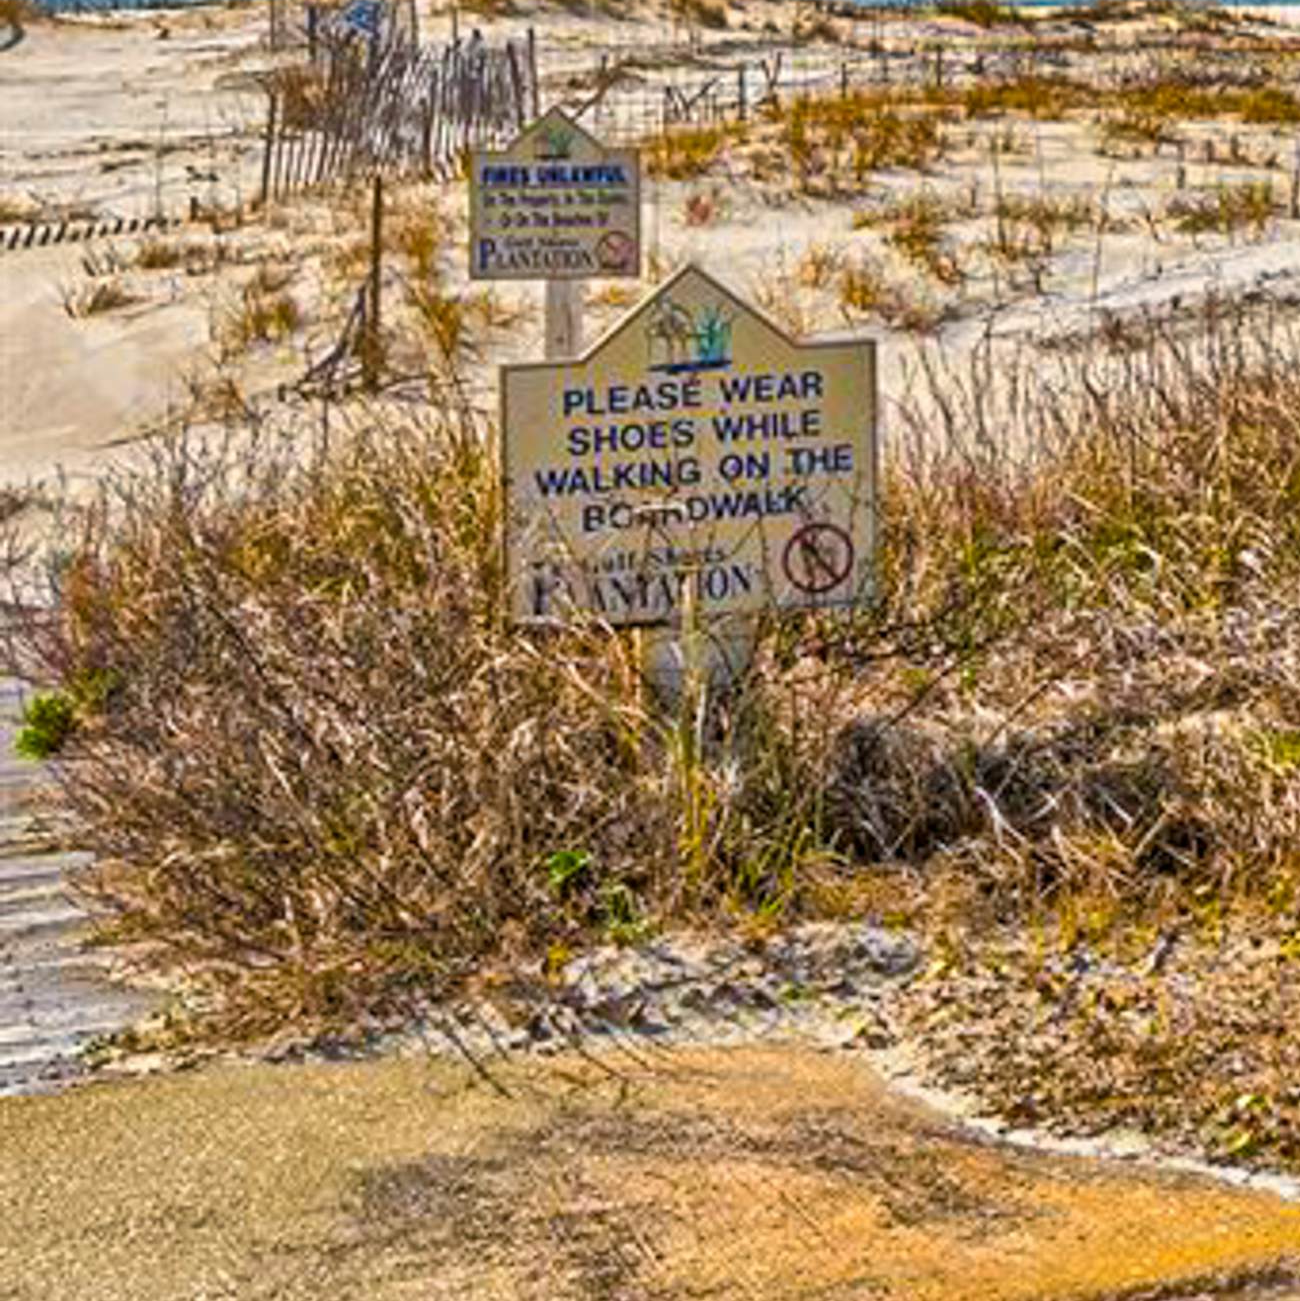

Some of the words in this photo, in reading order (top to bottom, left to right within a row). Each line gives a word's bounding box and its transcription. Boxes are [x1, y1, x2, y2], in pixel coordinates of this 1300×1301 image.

[562, 380, 702, 417] PLEASE
[719, 371, 824, 404] WEAR
[567, 420, 696, 456] SHOES
[711, 410, 822, 443] WHILE
[534, 457, 701, 496] WALKING
[718, 451, 770, 481] ON
[787, 444, 854, 476] THE
